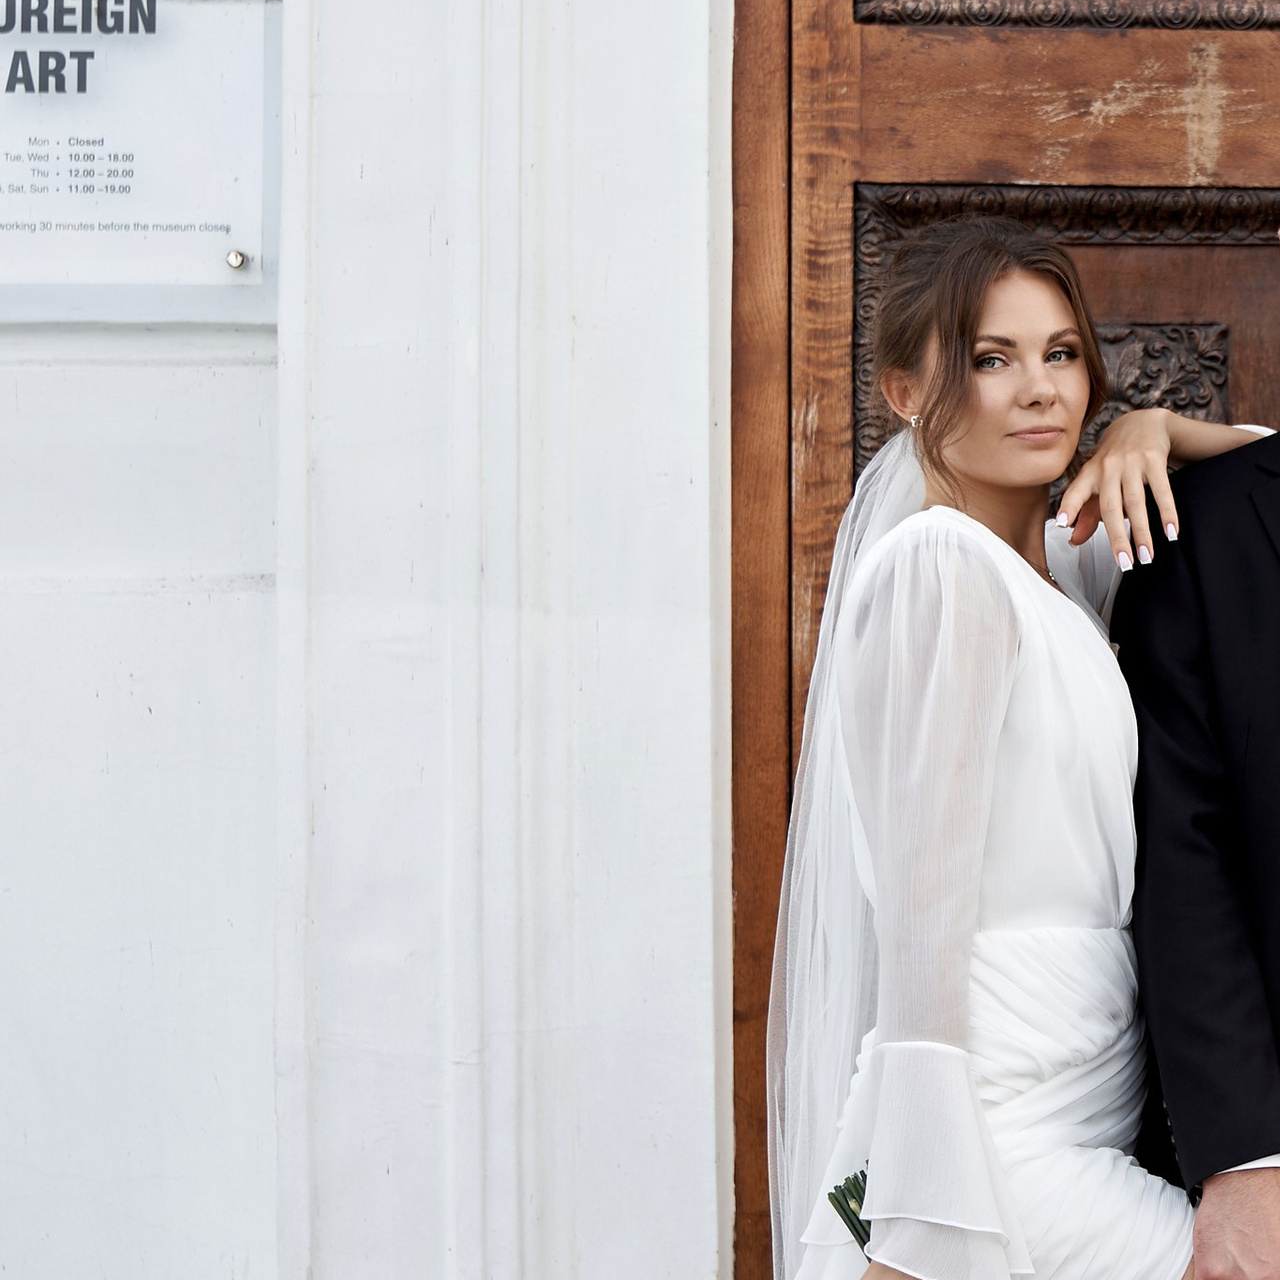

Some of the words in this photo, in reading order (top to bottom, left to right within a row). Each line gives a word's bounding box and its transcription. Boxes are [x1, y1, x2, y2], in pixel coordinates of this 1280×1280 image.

[5, 51, 95, 94] ART
[28, 137, 49, 147] Mon
[68, 137, 104, 147] Closed
[4, 153, 24, 163] Tue,
[28, 153, 49, 162] Wed
[68, 153, 95, 163] 10.00
[107, 153, 134, 163] 18.00
[31, 169, 49, 178] Thu
[68, 169, 95, 179] 12.00
[106, 169, 134, 179] 20.00
[30, 184, 49, 194] Sun
[68, 184, 95, 194] 11.00
[39, 221, 52, 231] 30
[55, 221, 95, 231] minutes
[98, 221, 130, 232] before
[133, 222, 149, 232] the
[152, 223, 196, 232] museum
